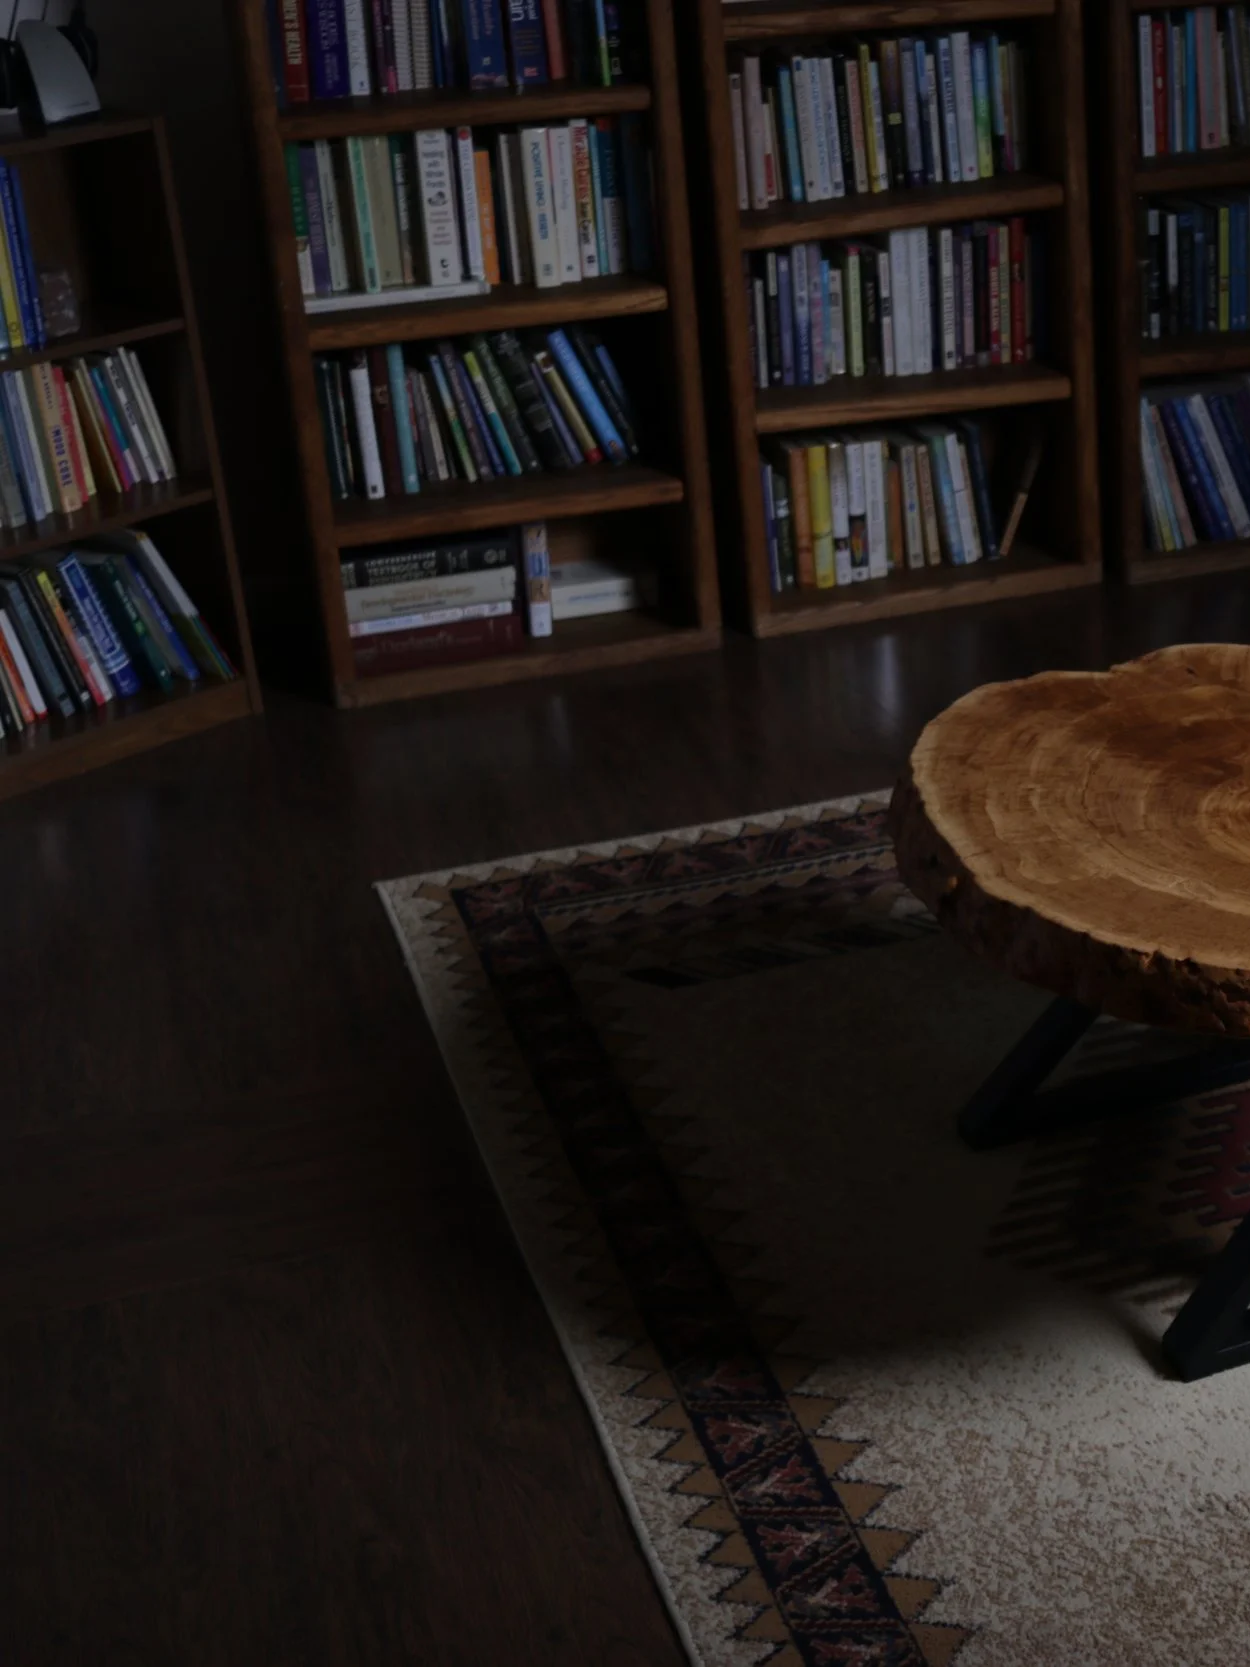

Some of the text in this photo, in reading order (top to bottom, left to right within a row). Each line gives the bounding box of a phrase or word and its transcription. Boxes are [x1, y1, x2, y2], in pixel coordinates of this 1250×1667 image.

[284, 31, 303, 65] HEALTH
[530, 141, 544, 178] POSITIVE
[572, 127, 590, 166] Miracle
[576, 168, 590, 201] Cures
